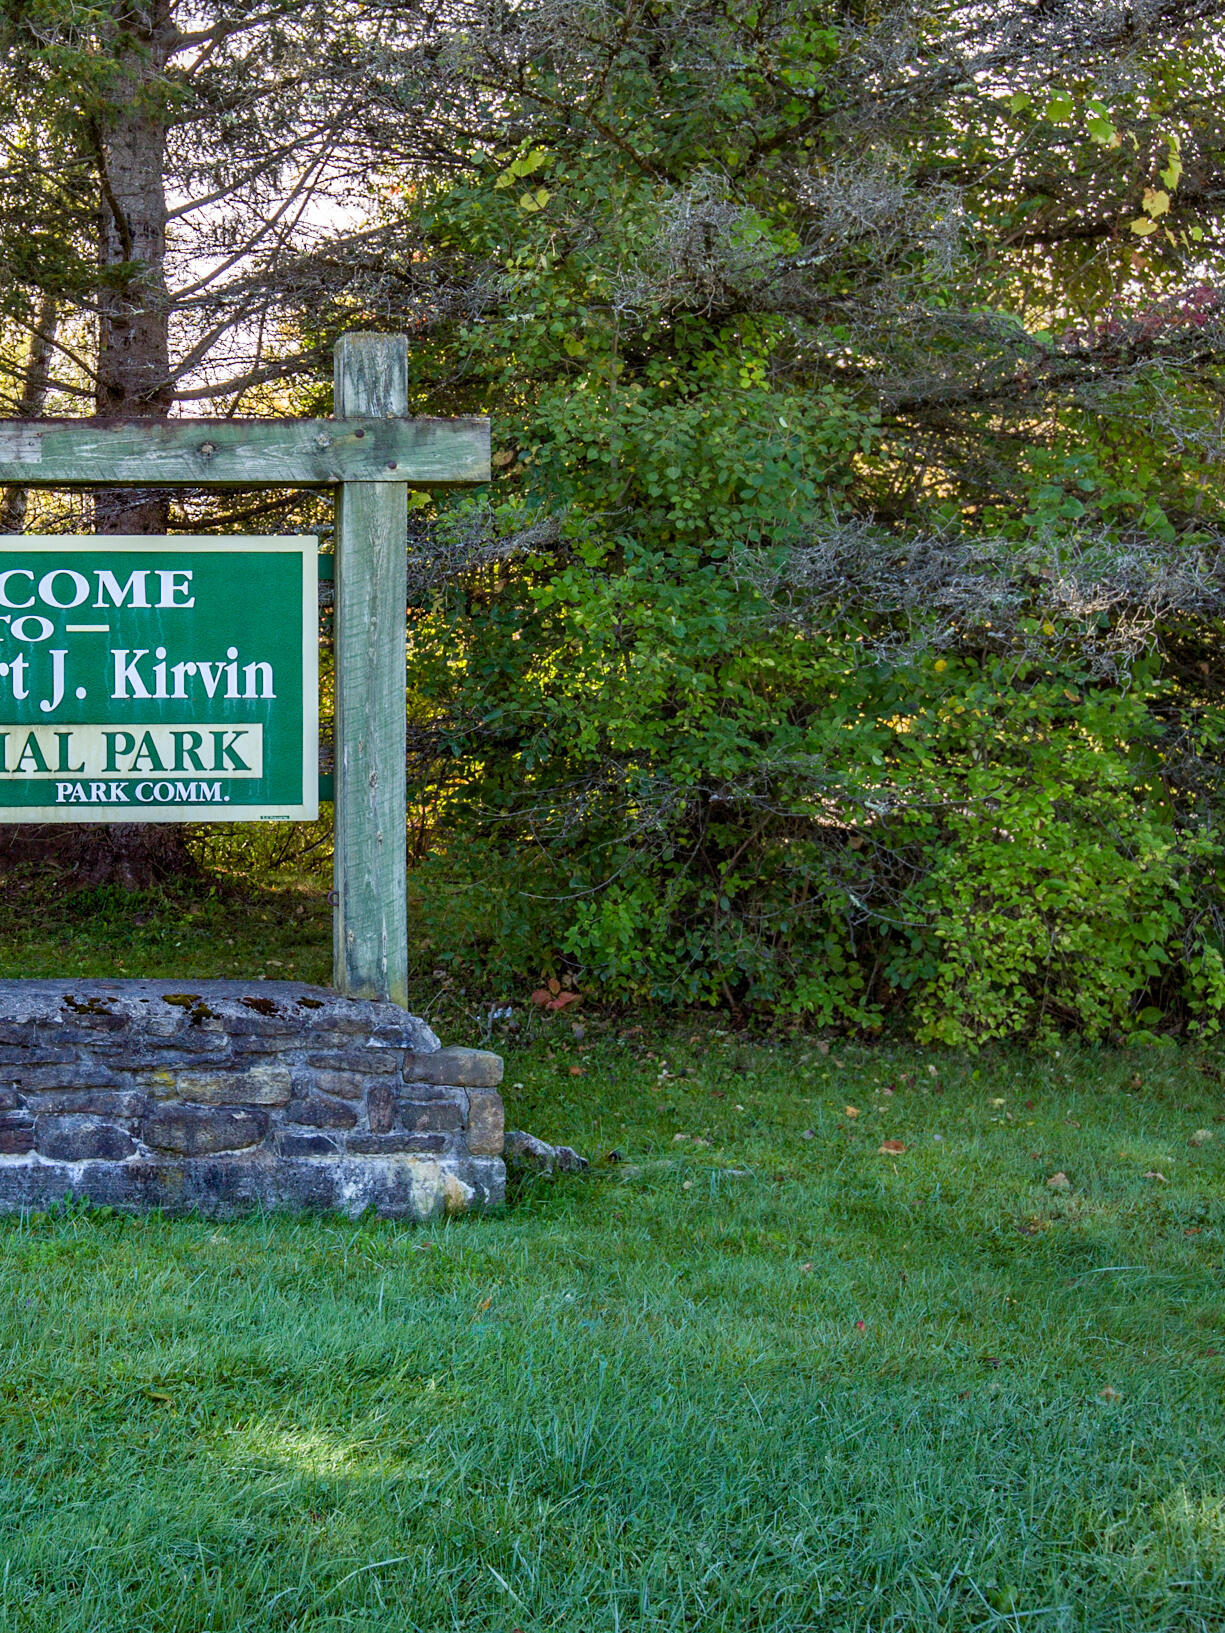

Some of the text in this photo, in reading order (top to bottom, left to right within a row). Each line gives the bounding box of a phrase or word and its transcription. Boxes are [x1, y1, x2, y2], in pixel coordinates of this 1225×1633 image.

[40, 649, 87, 712] J.
[110, 646, 277, 699] Kirvin
[101, 730, 251, 772] PARK
[56, 781, 230, 803] PARK COMM.
